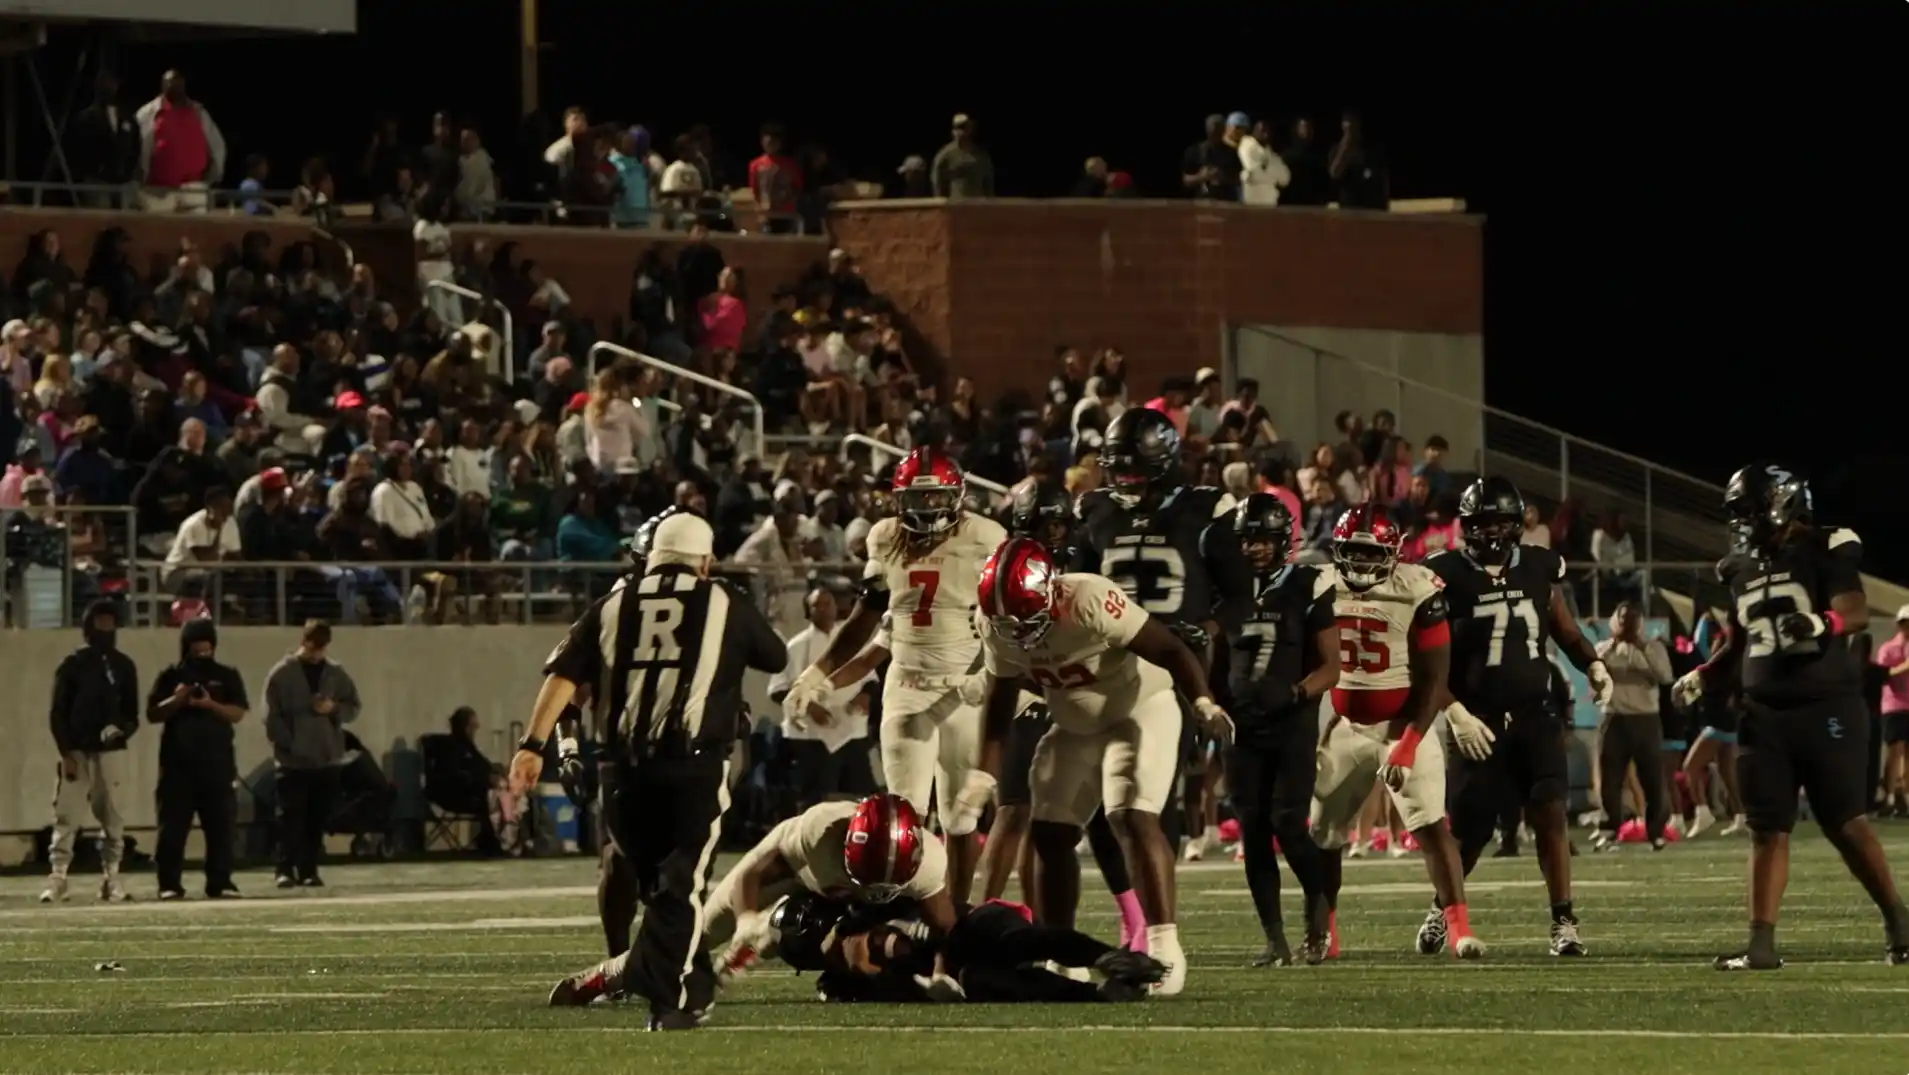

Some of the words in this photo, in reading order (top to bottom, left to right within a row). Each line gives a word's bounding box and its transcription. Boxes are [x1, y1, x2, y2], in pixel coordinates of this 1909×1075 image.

[910, 571, 939, 627] 7
[1100, 546, 1185, 614] 53
[1104, 590, 1126, 620] 92
[632, 597, 684, 662] R
[1240, 622, 1277, 682] 7
[1472, 598, 1540, 668] 71
